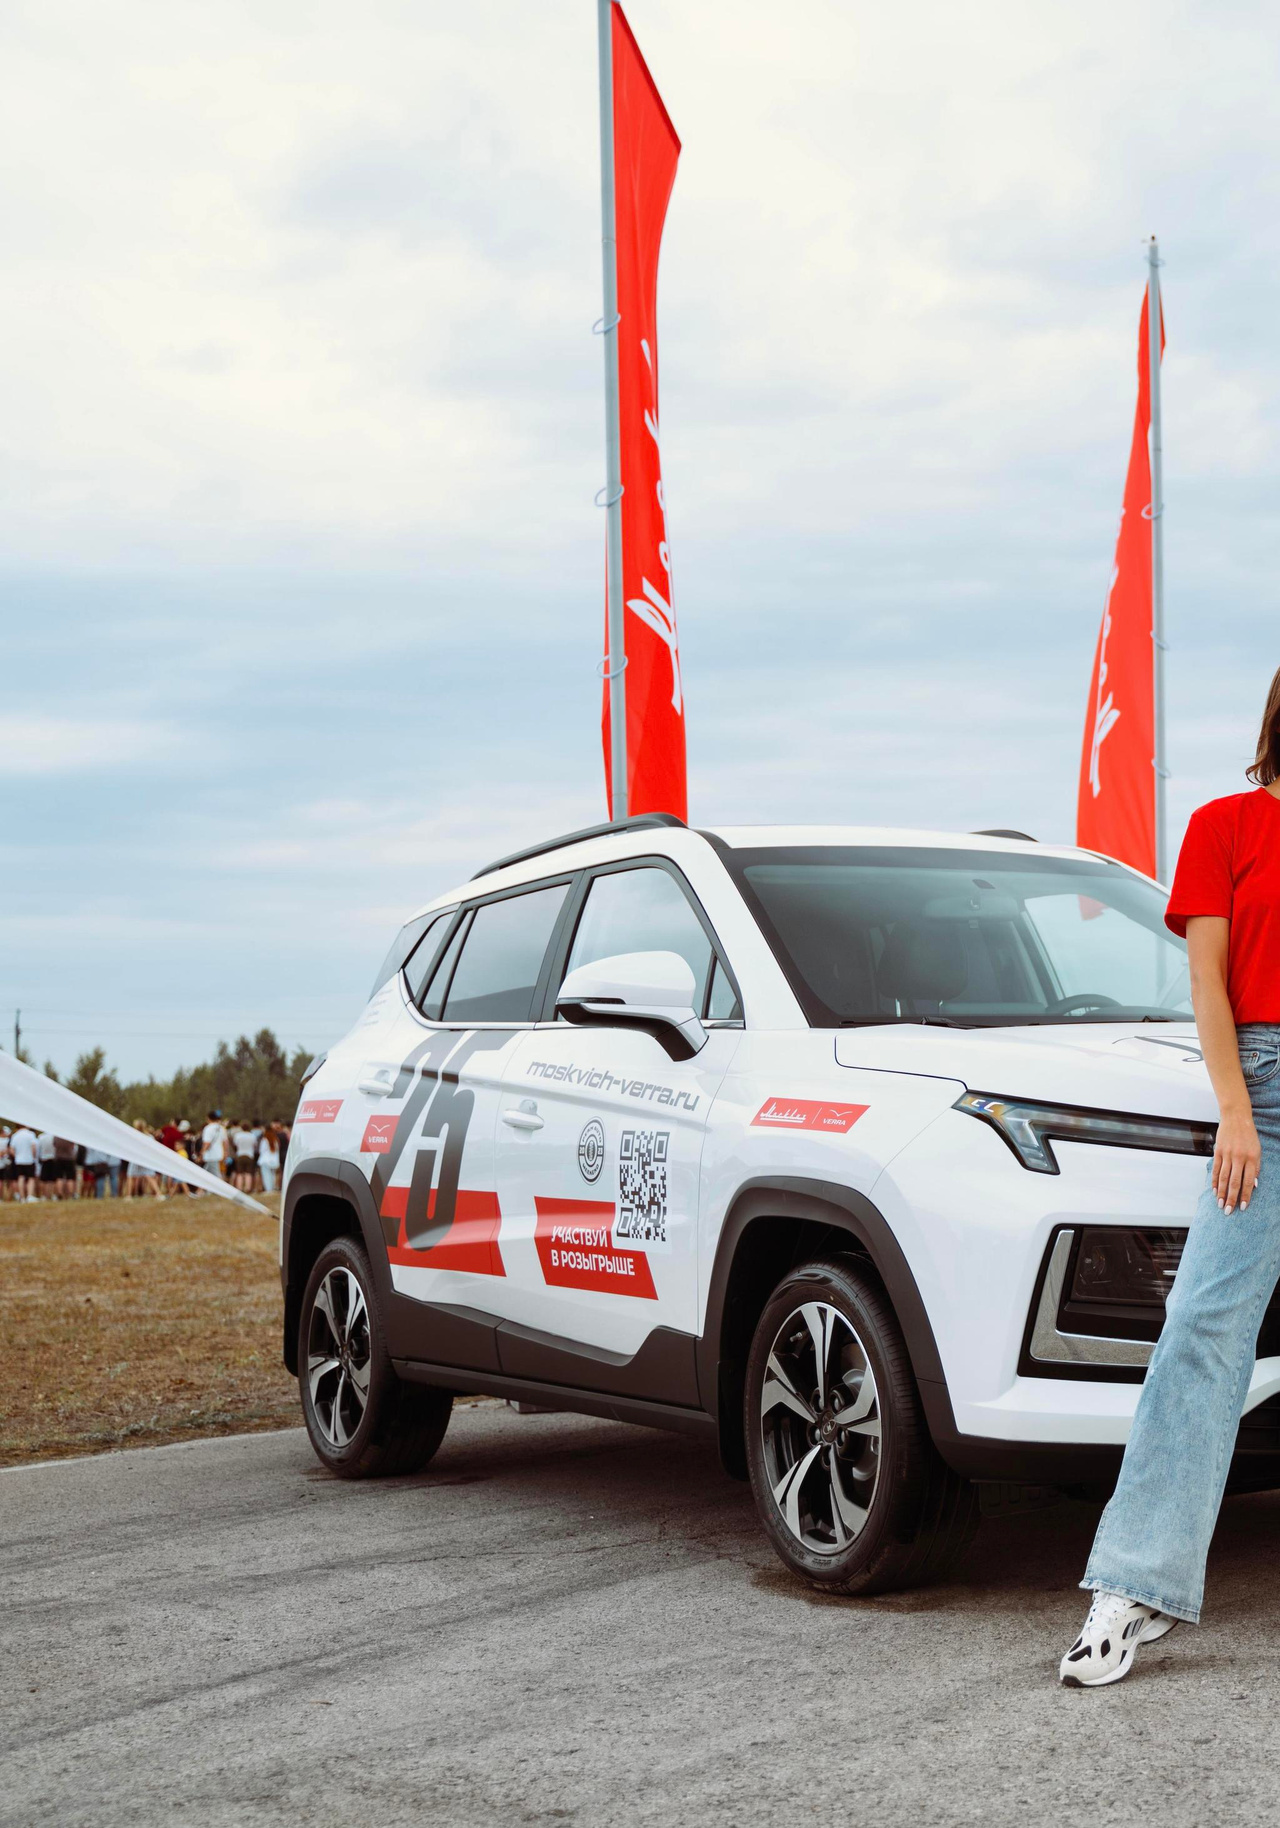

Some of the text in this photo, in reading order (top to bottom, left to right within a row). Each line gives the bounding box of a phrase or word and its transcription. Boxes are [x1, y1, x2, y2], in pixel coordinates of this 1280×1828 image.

[526, 1061, 700, 1111] moskvich-verra.ru
[823, 1118, 846, 1126] VERRA
[368, 1136, 388, 1144] VERRA
[551, 1225, 608, 1248] УЧАСТВУЙ
[551, 1249, 636, 1276] В РОЗЫГРЫШЕ
